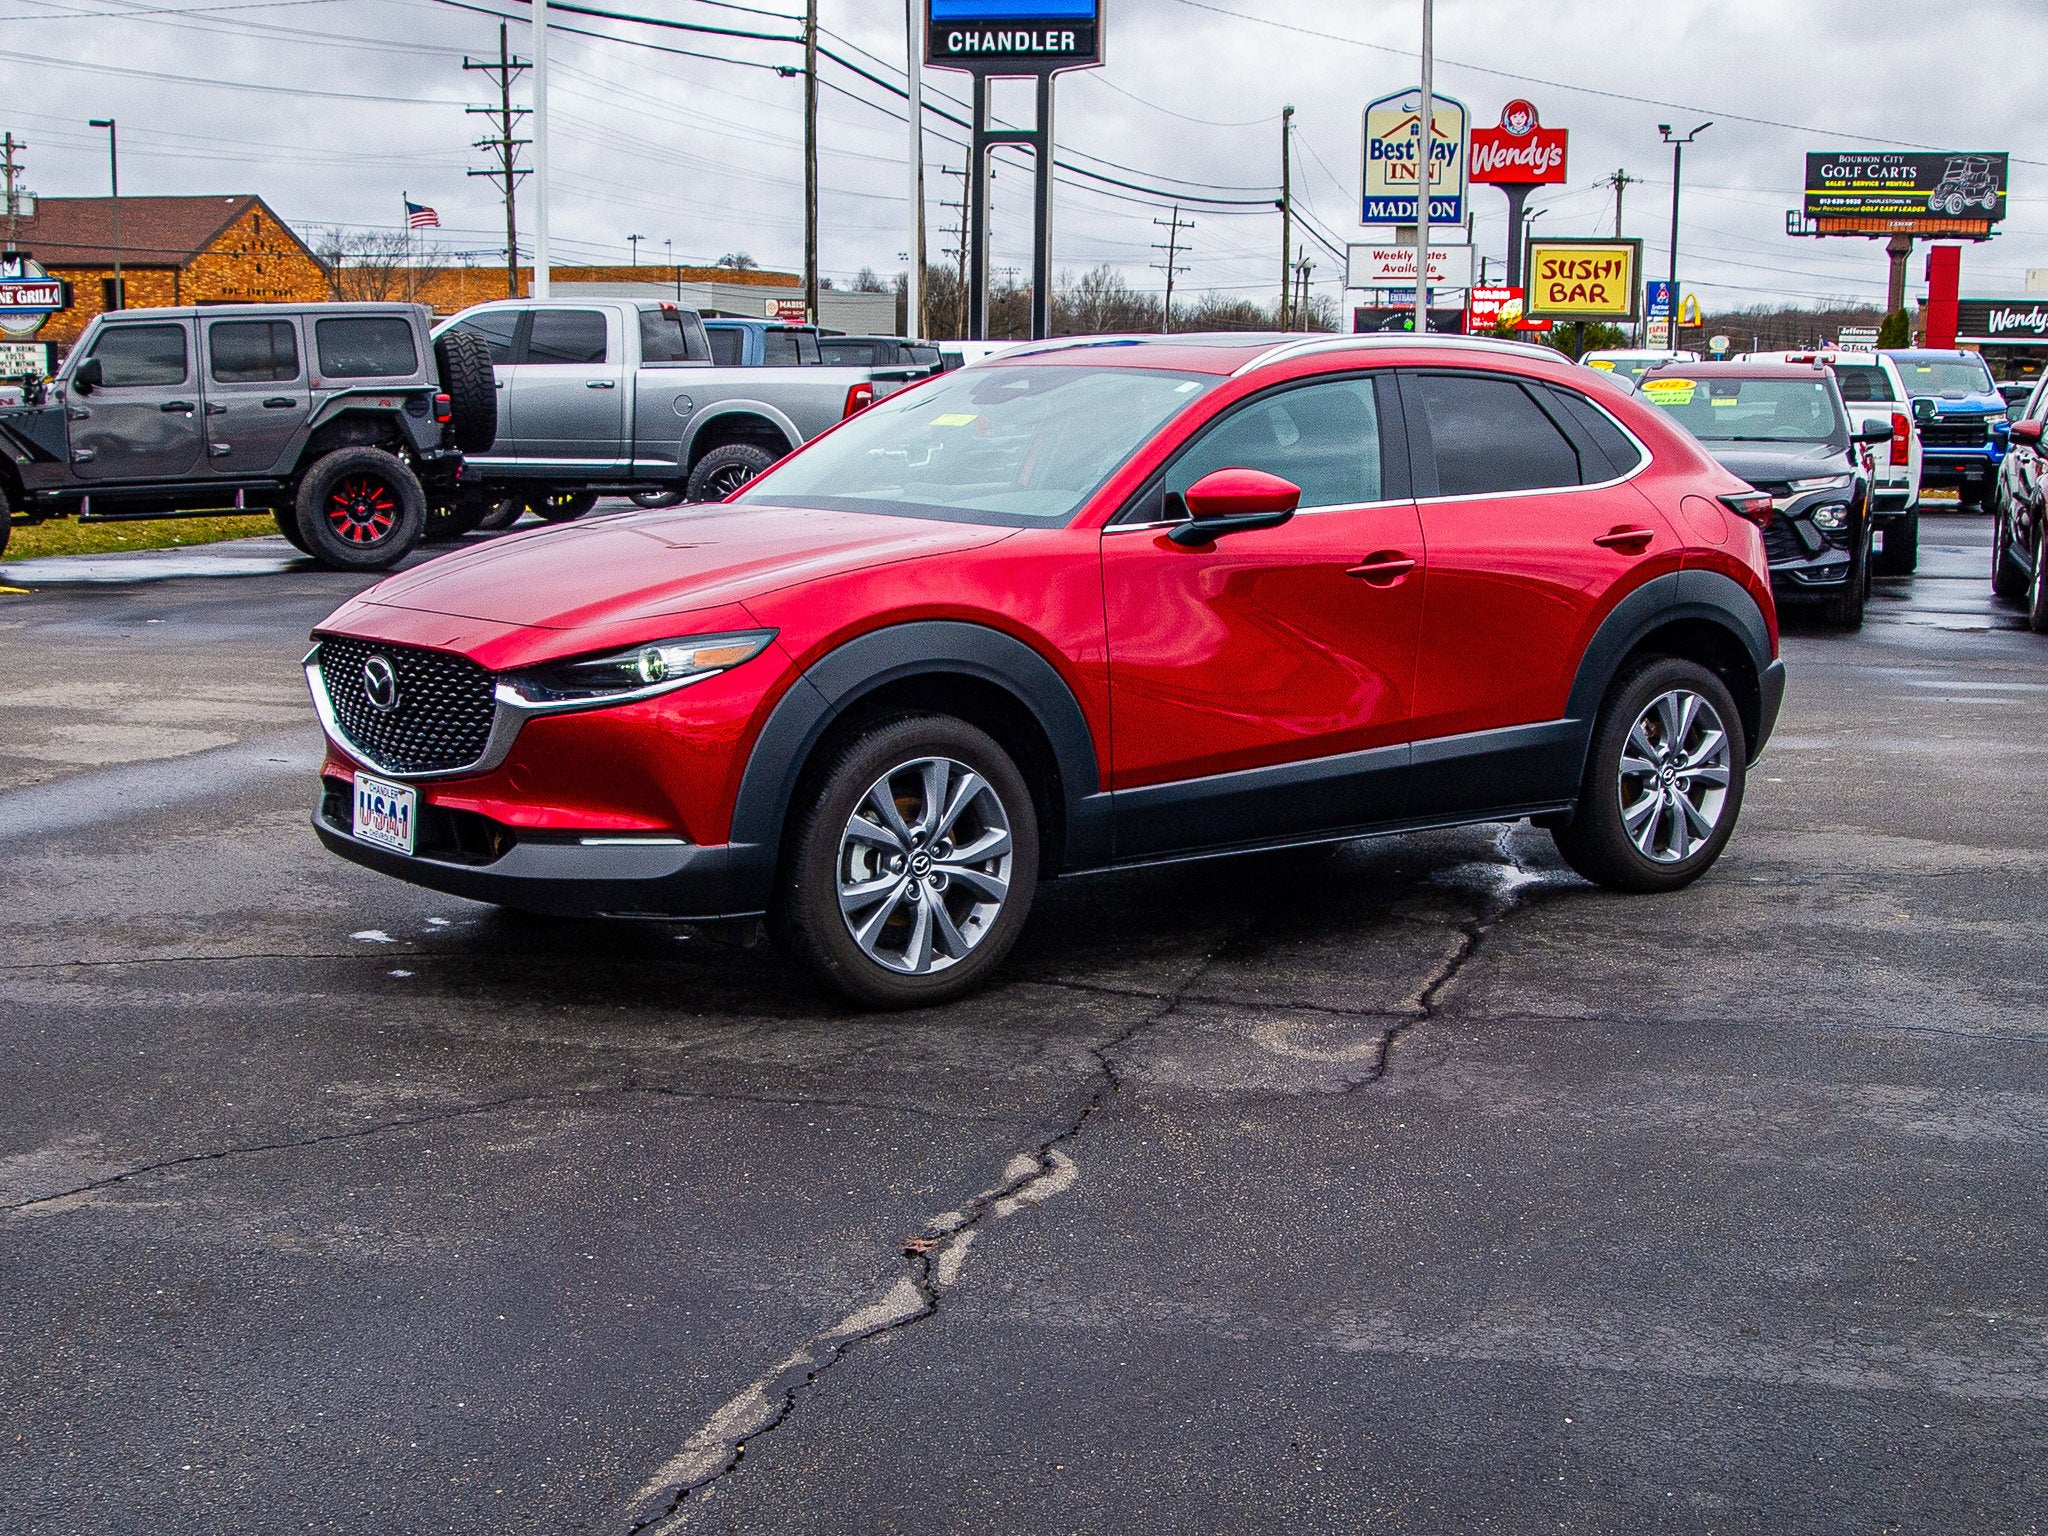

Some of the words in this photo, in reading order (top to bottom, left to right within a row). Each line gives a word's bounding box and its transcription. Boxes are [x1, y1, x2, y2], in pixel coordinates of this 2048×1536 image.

[948, 31, 1076, 51] CHANDLER
[1370, 138, 1415, 160] Best
[1472, 135, 1563, 175] Wendy's
[1839, 155, 1880, 163] BOURBON
[1883, 155, 1904, 163] CITY
[1820, 164, 1861, 178] GOLF
[1867, 164, 1917, 178] CARTS
[1368, 202, 1457, 217] MADION
[1373, 250, 1413, 262] Weekly
[1426, 251, 1448, 260] ates
[1382, 263, 1437, 273] Availale
[1541, 259, 1622, 280] SUSHI
[16, 288, 53, 304] GRILL
[1550, 282, 1609, 303] BAR
[1841, 327, 1878, 335] Jefferson
[369, 782, 399, 801] CHANDLER
